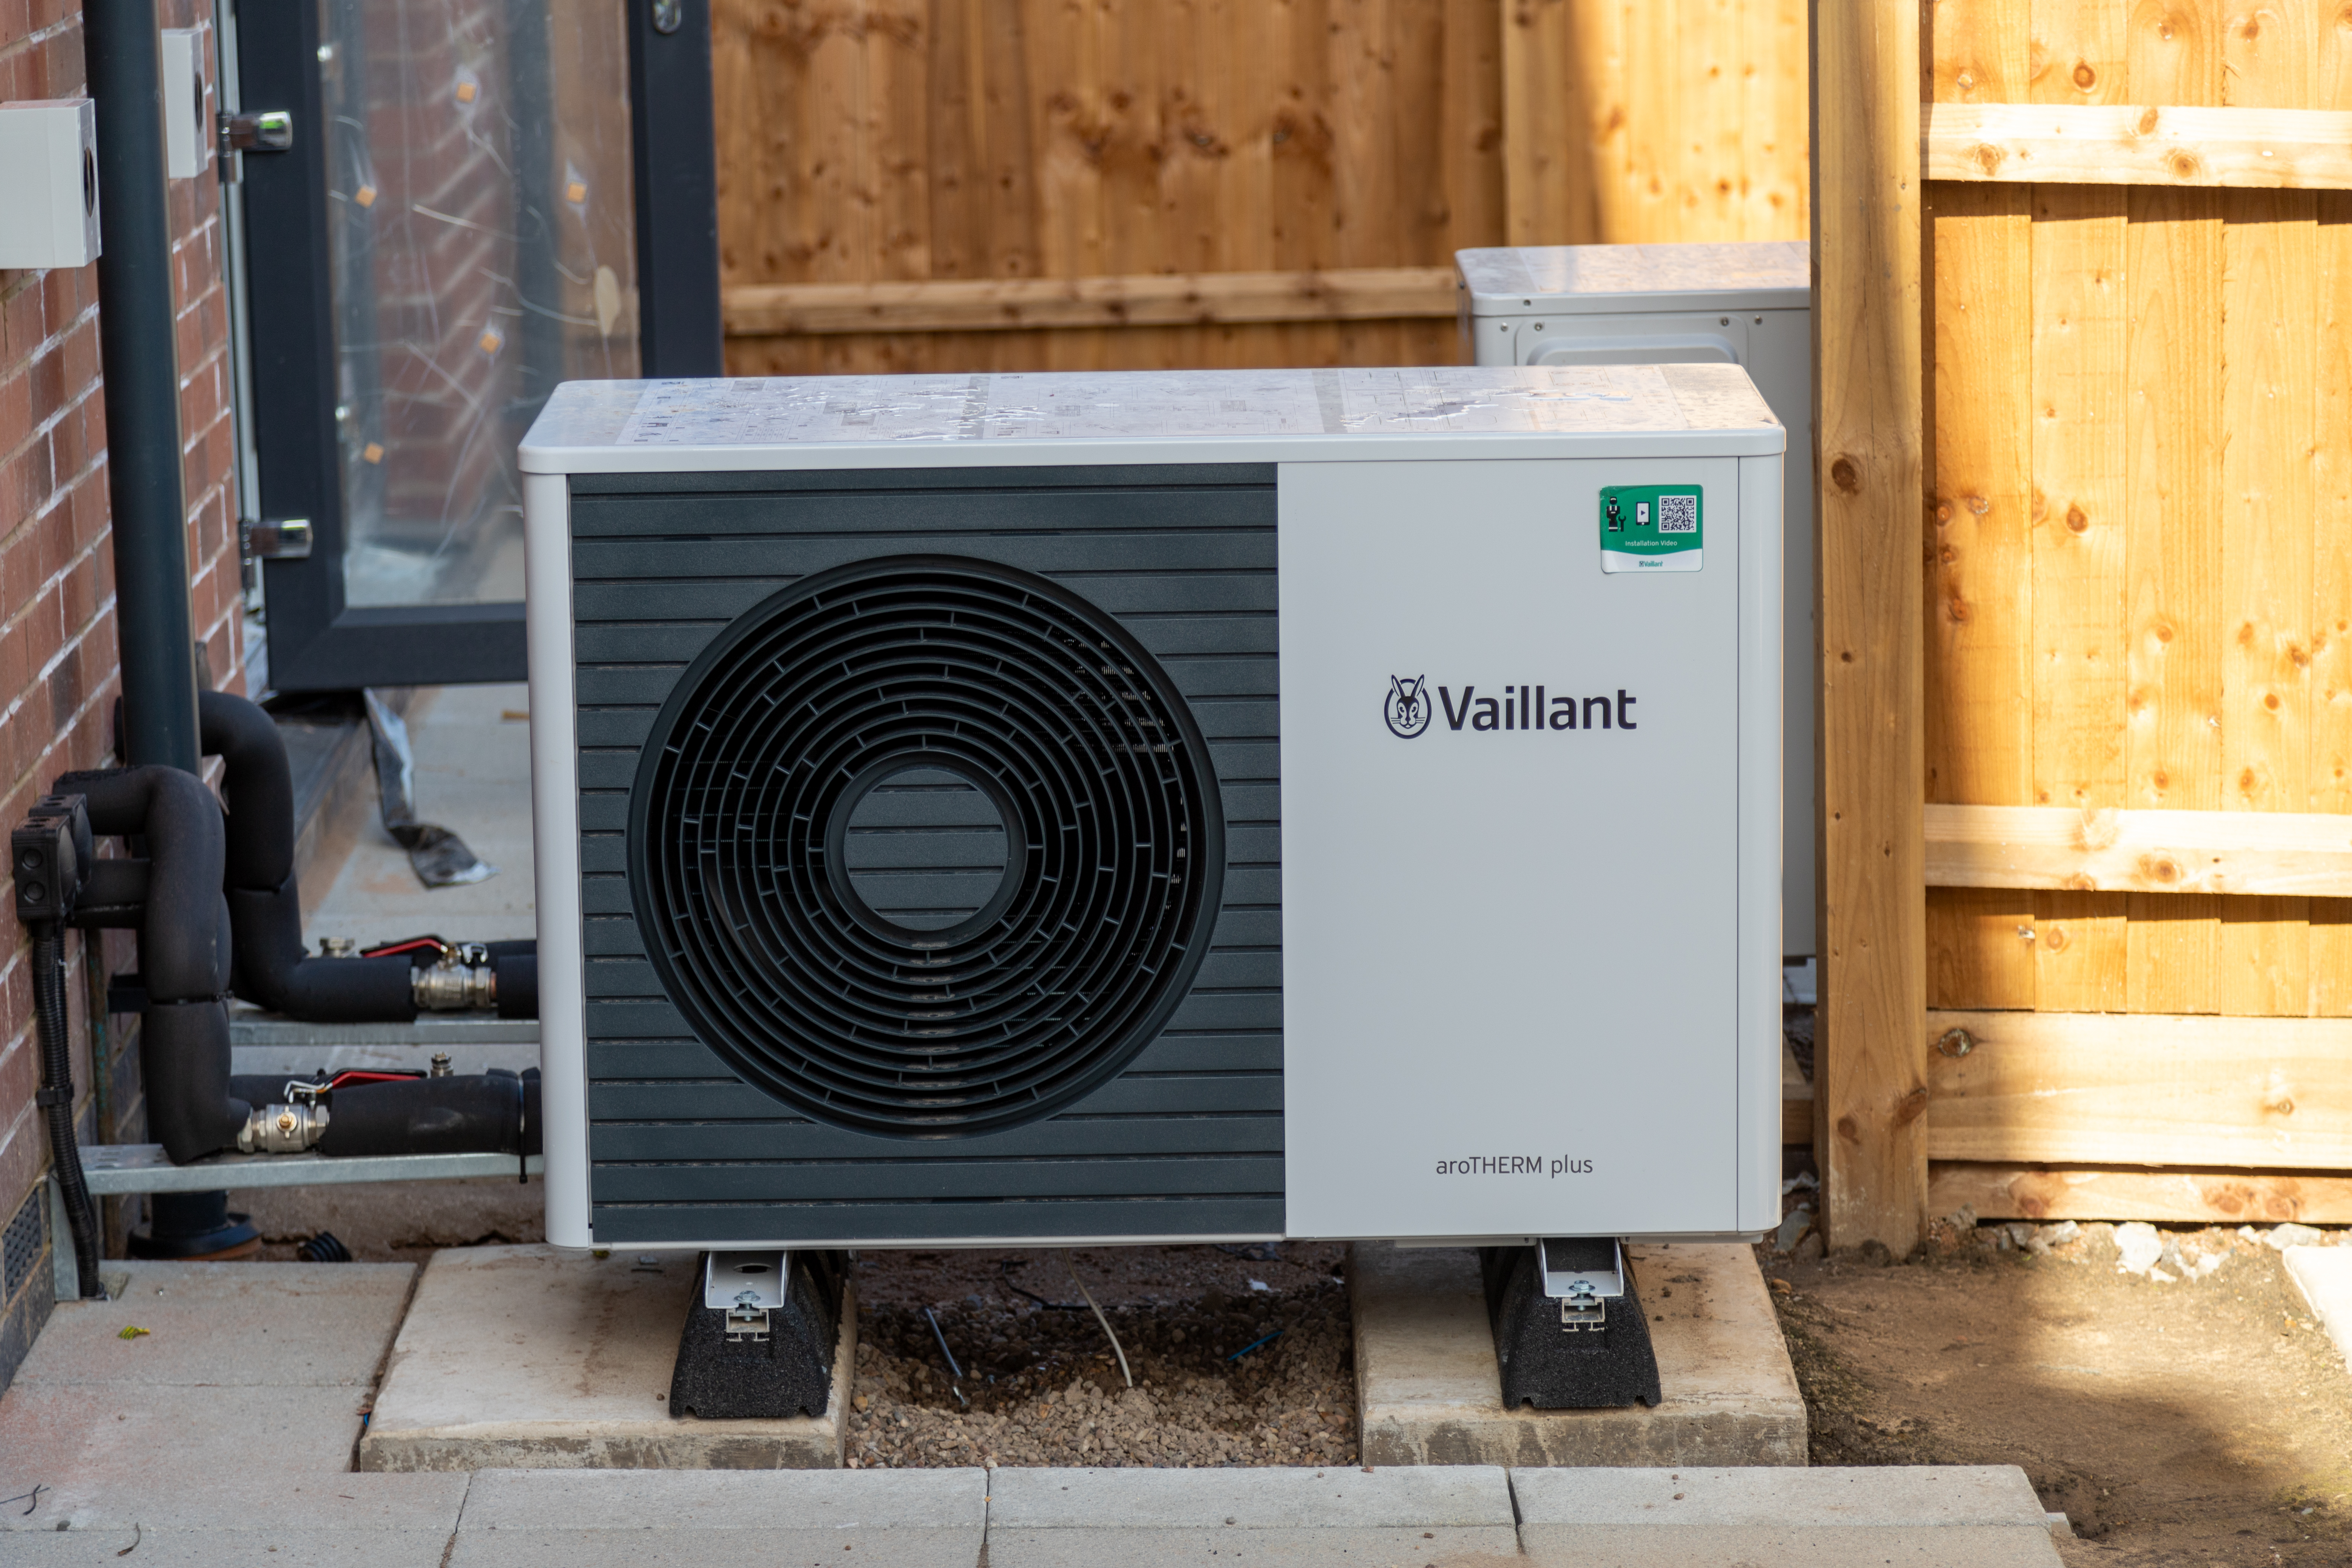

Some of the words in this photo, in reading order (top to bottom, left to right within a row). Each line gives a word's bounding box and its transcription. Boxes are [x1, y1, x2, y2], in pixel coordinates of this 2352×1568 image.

[1438, 686, 1637, 731] Vaillant
[1436, 1156, 1542, 1174] aroTHERM
[1552, 1154, 1593, 1179] plus
